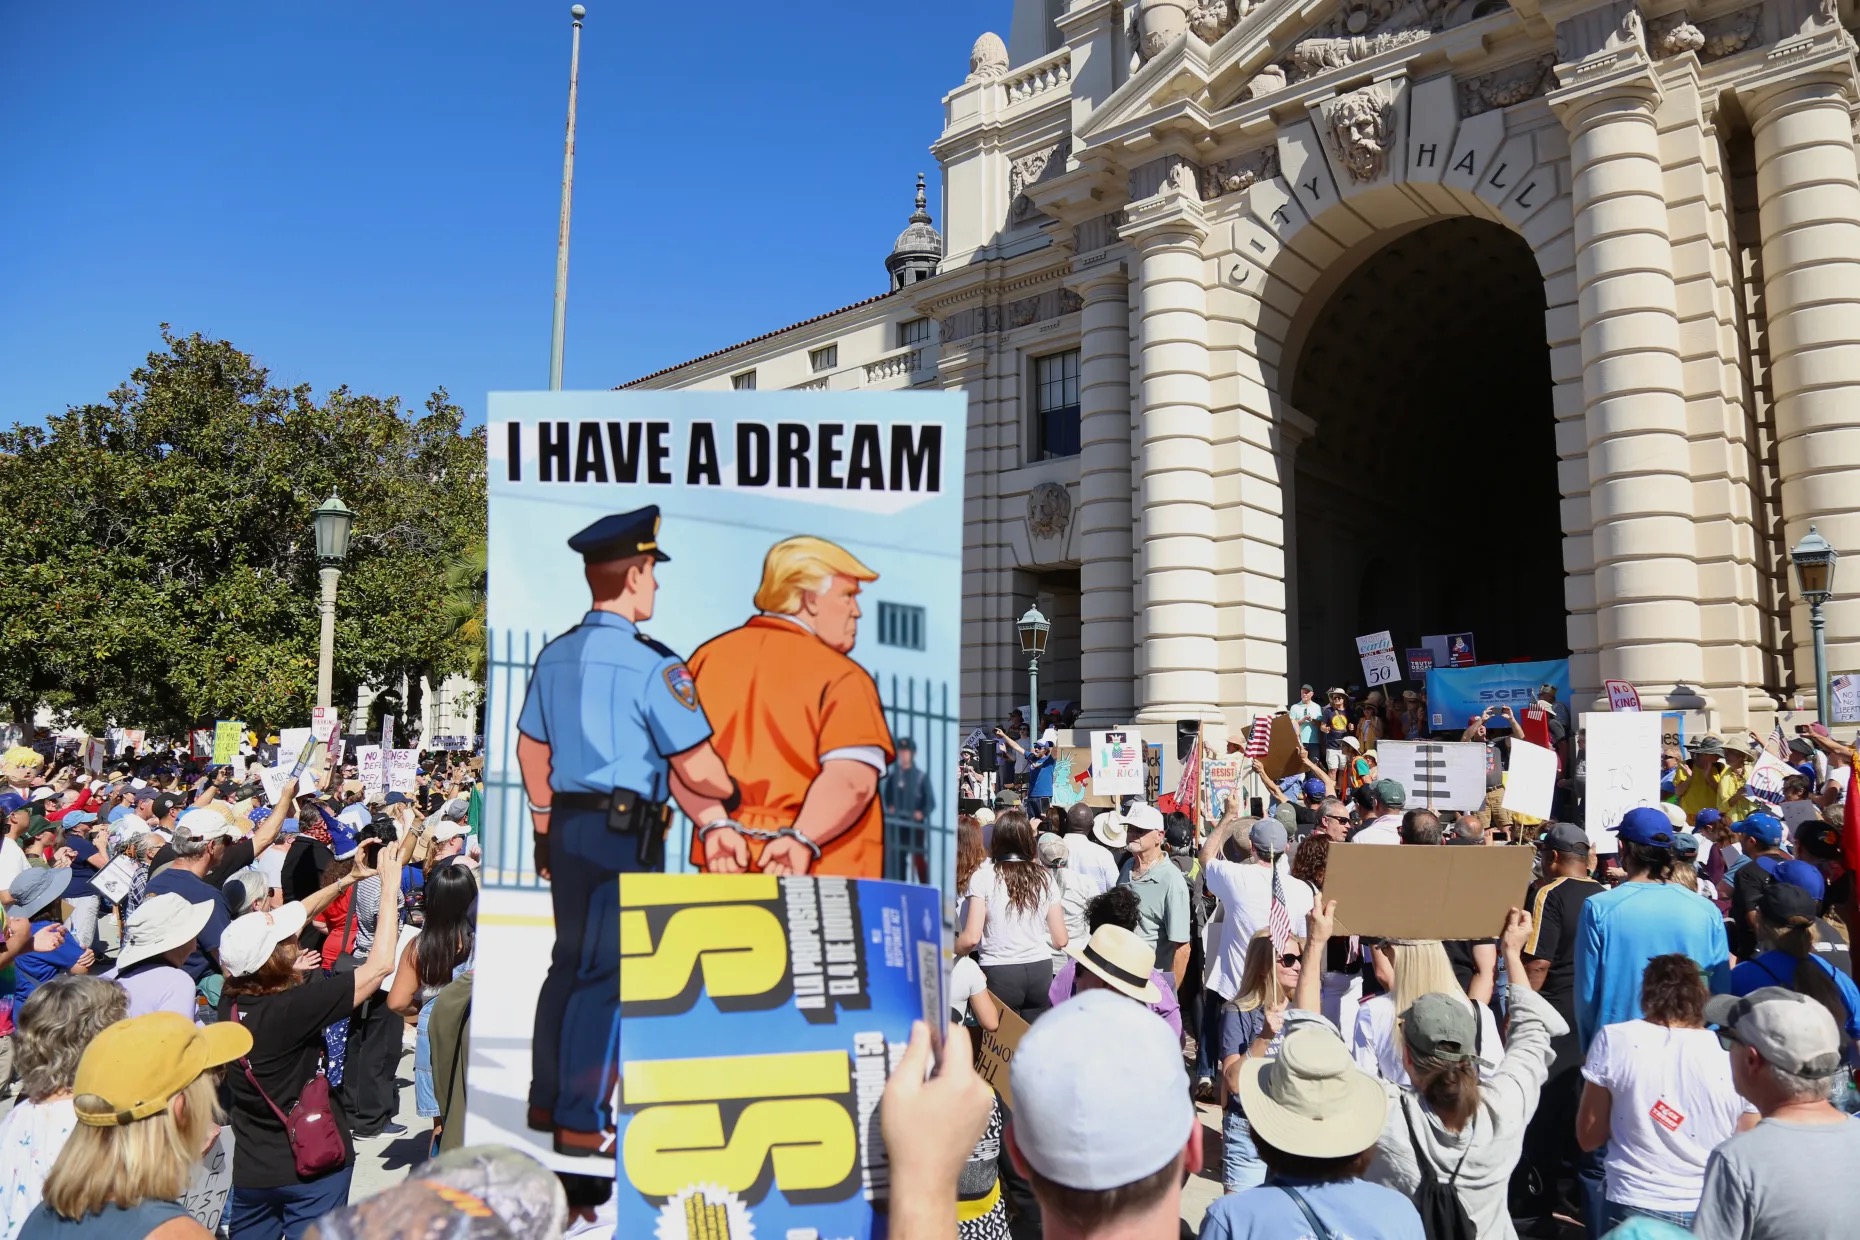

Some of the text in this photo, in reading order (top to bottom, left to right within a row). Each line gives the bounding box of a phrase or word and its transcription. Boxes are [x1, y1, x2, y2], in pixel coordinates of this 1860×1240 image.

[1230, 143, 1537, 282] CITY HALL
[507, 421, 942, 492] I HAVE A DREAM
[1361, 639, 1390, 652] early
[1370, 666, 1391, 684] 50
[1613, 685, 1629, 694] NO
[314, 708, 323, 716] NO
[365, 752, 377, 760] NO
[360, 773, 379, 782] DEFY
[1211, 768, 1235, 777] RESIST
[1607, 765, 1633, 790] IS
[779, 876, 826, 1009] A LA PROPOSICIÓ
[825, 942, 857, 962] DE
[826, 962, 858, 976] 4
[923, 947, 937, 990] Party
[828, 977, 860, 995] EL
[854, 1031, 885, 1055] 50
